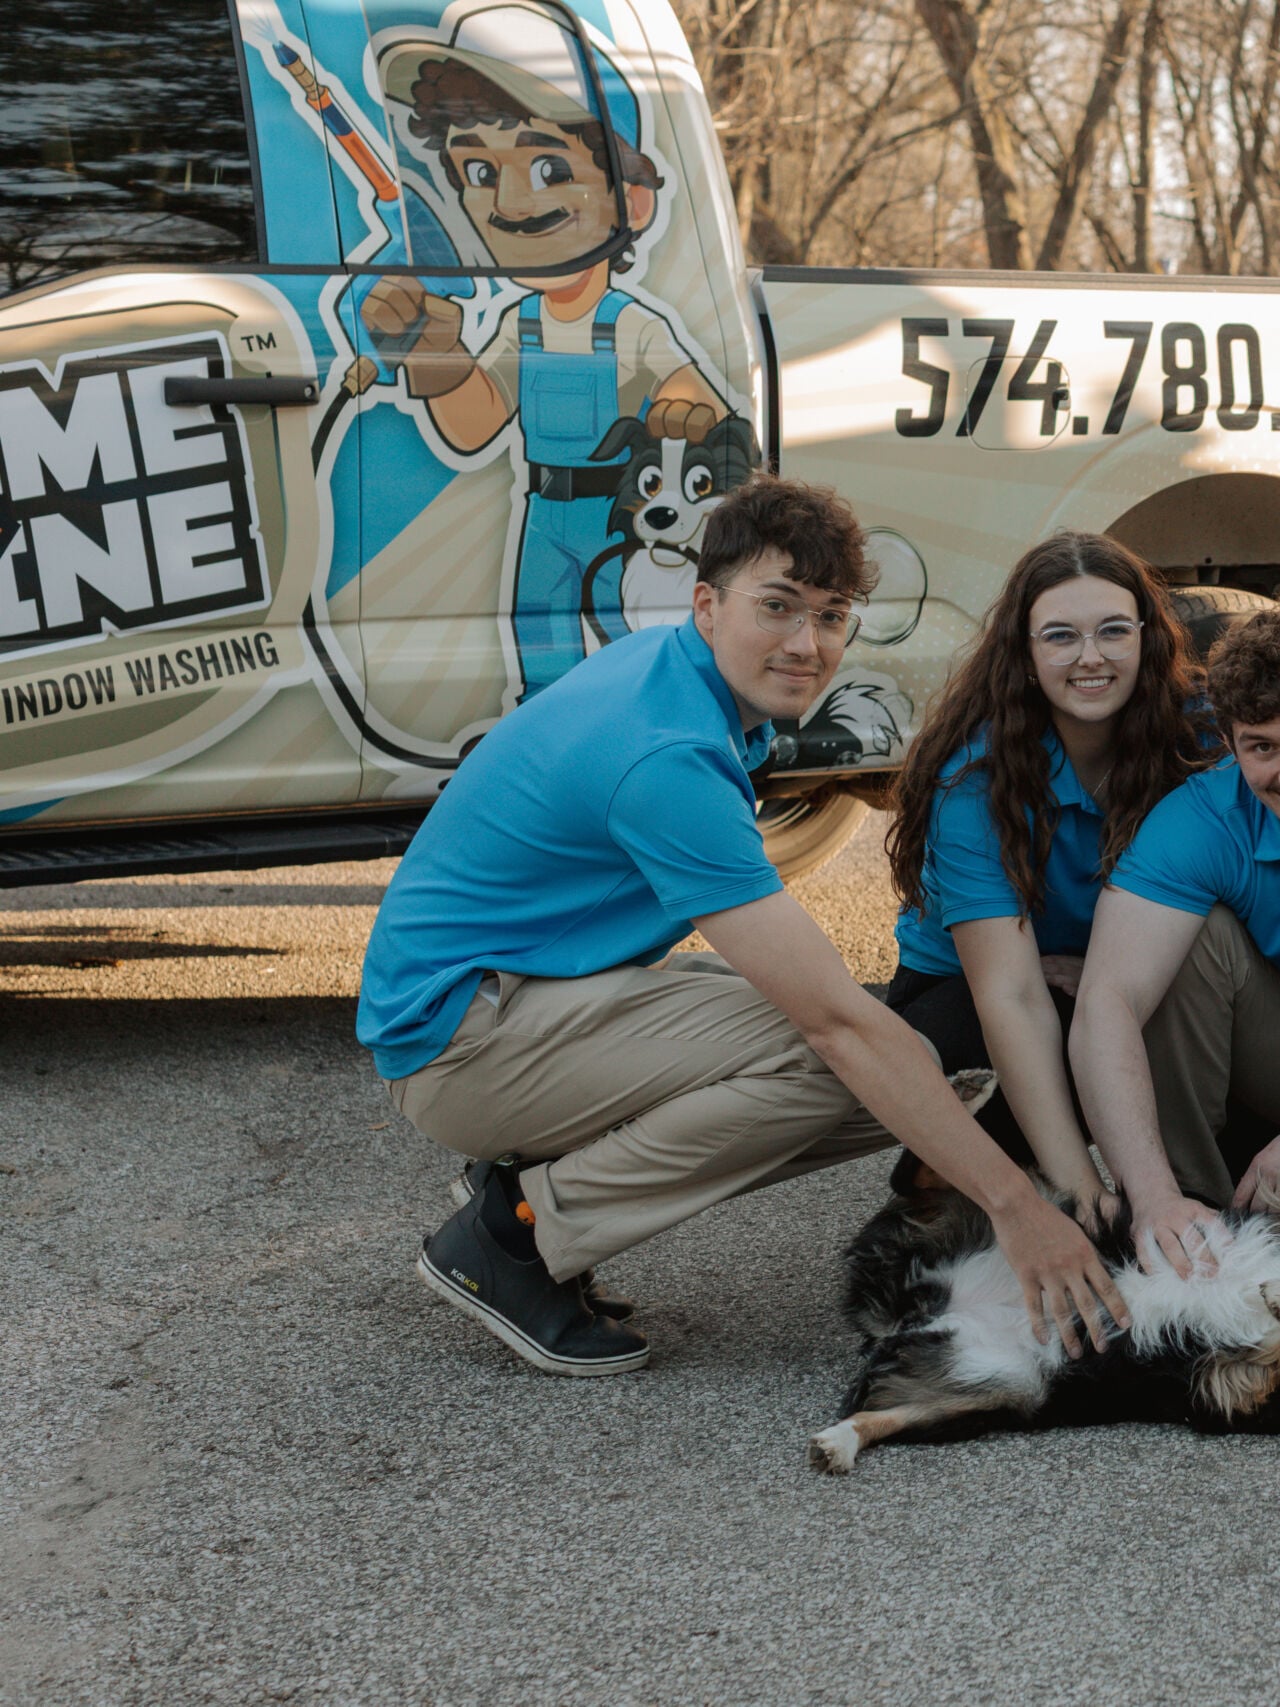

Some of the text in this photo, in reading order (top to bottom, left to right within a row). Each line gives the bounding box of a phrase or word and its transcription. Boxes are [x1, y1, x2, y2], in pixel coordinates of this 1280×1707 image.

[241, 332, 277, 352] TM
[0, 357, 228, 501] ME
[124, 631, 280, 697] WASHING
